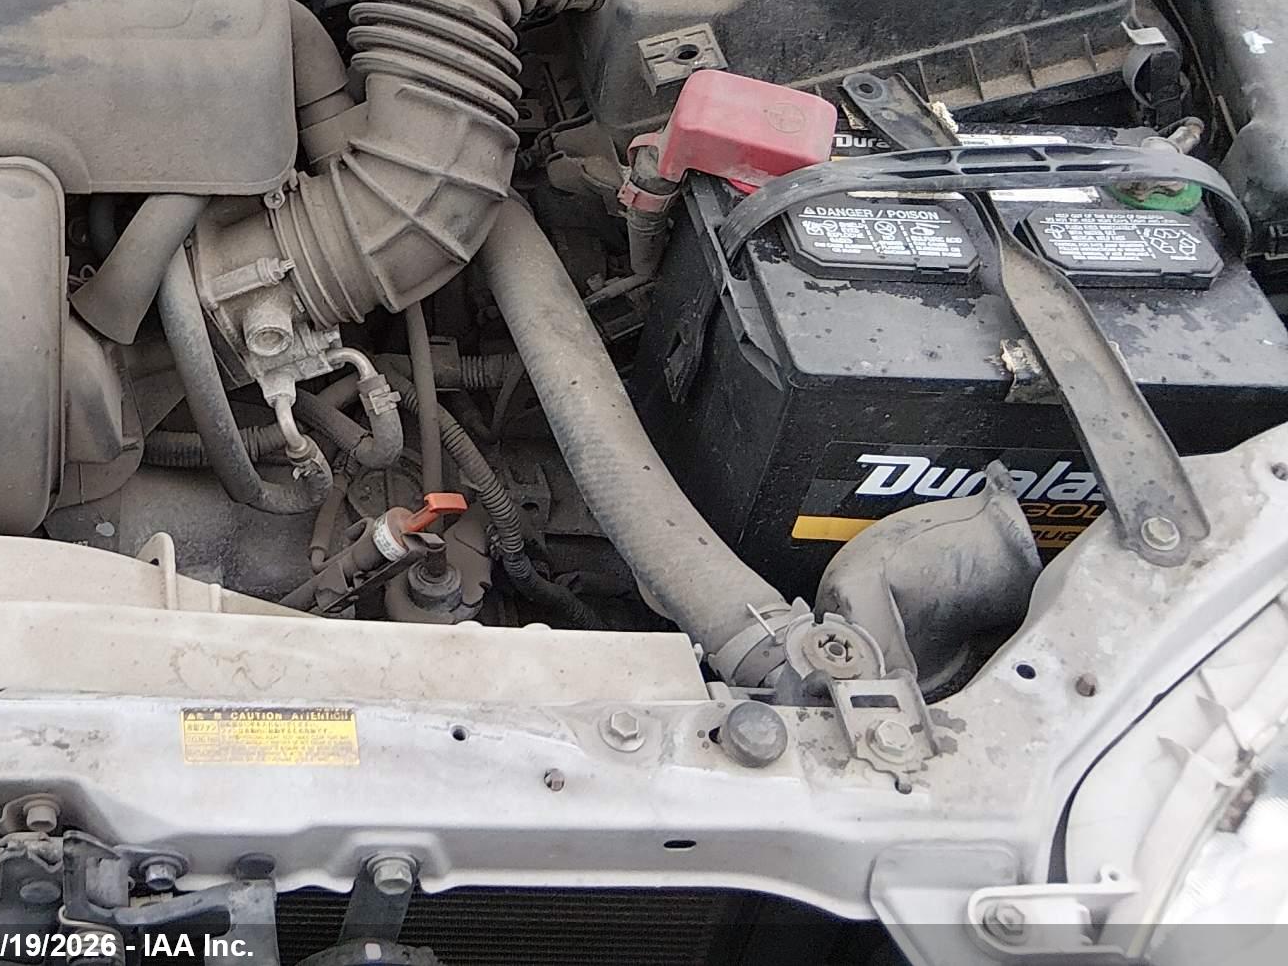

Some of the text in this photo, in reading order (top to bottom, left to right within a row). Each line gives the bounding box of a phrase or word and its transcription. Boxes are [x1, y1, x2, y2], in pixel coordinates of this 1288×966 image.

[815, 206, 939, 221] DANGER / POISON
[230, 711, 283, 721] CAUTION
